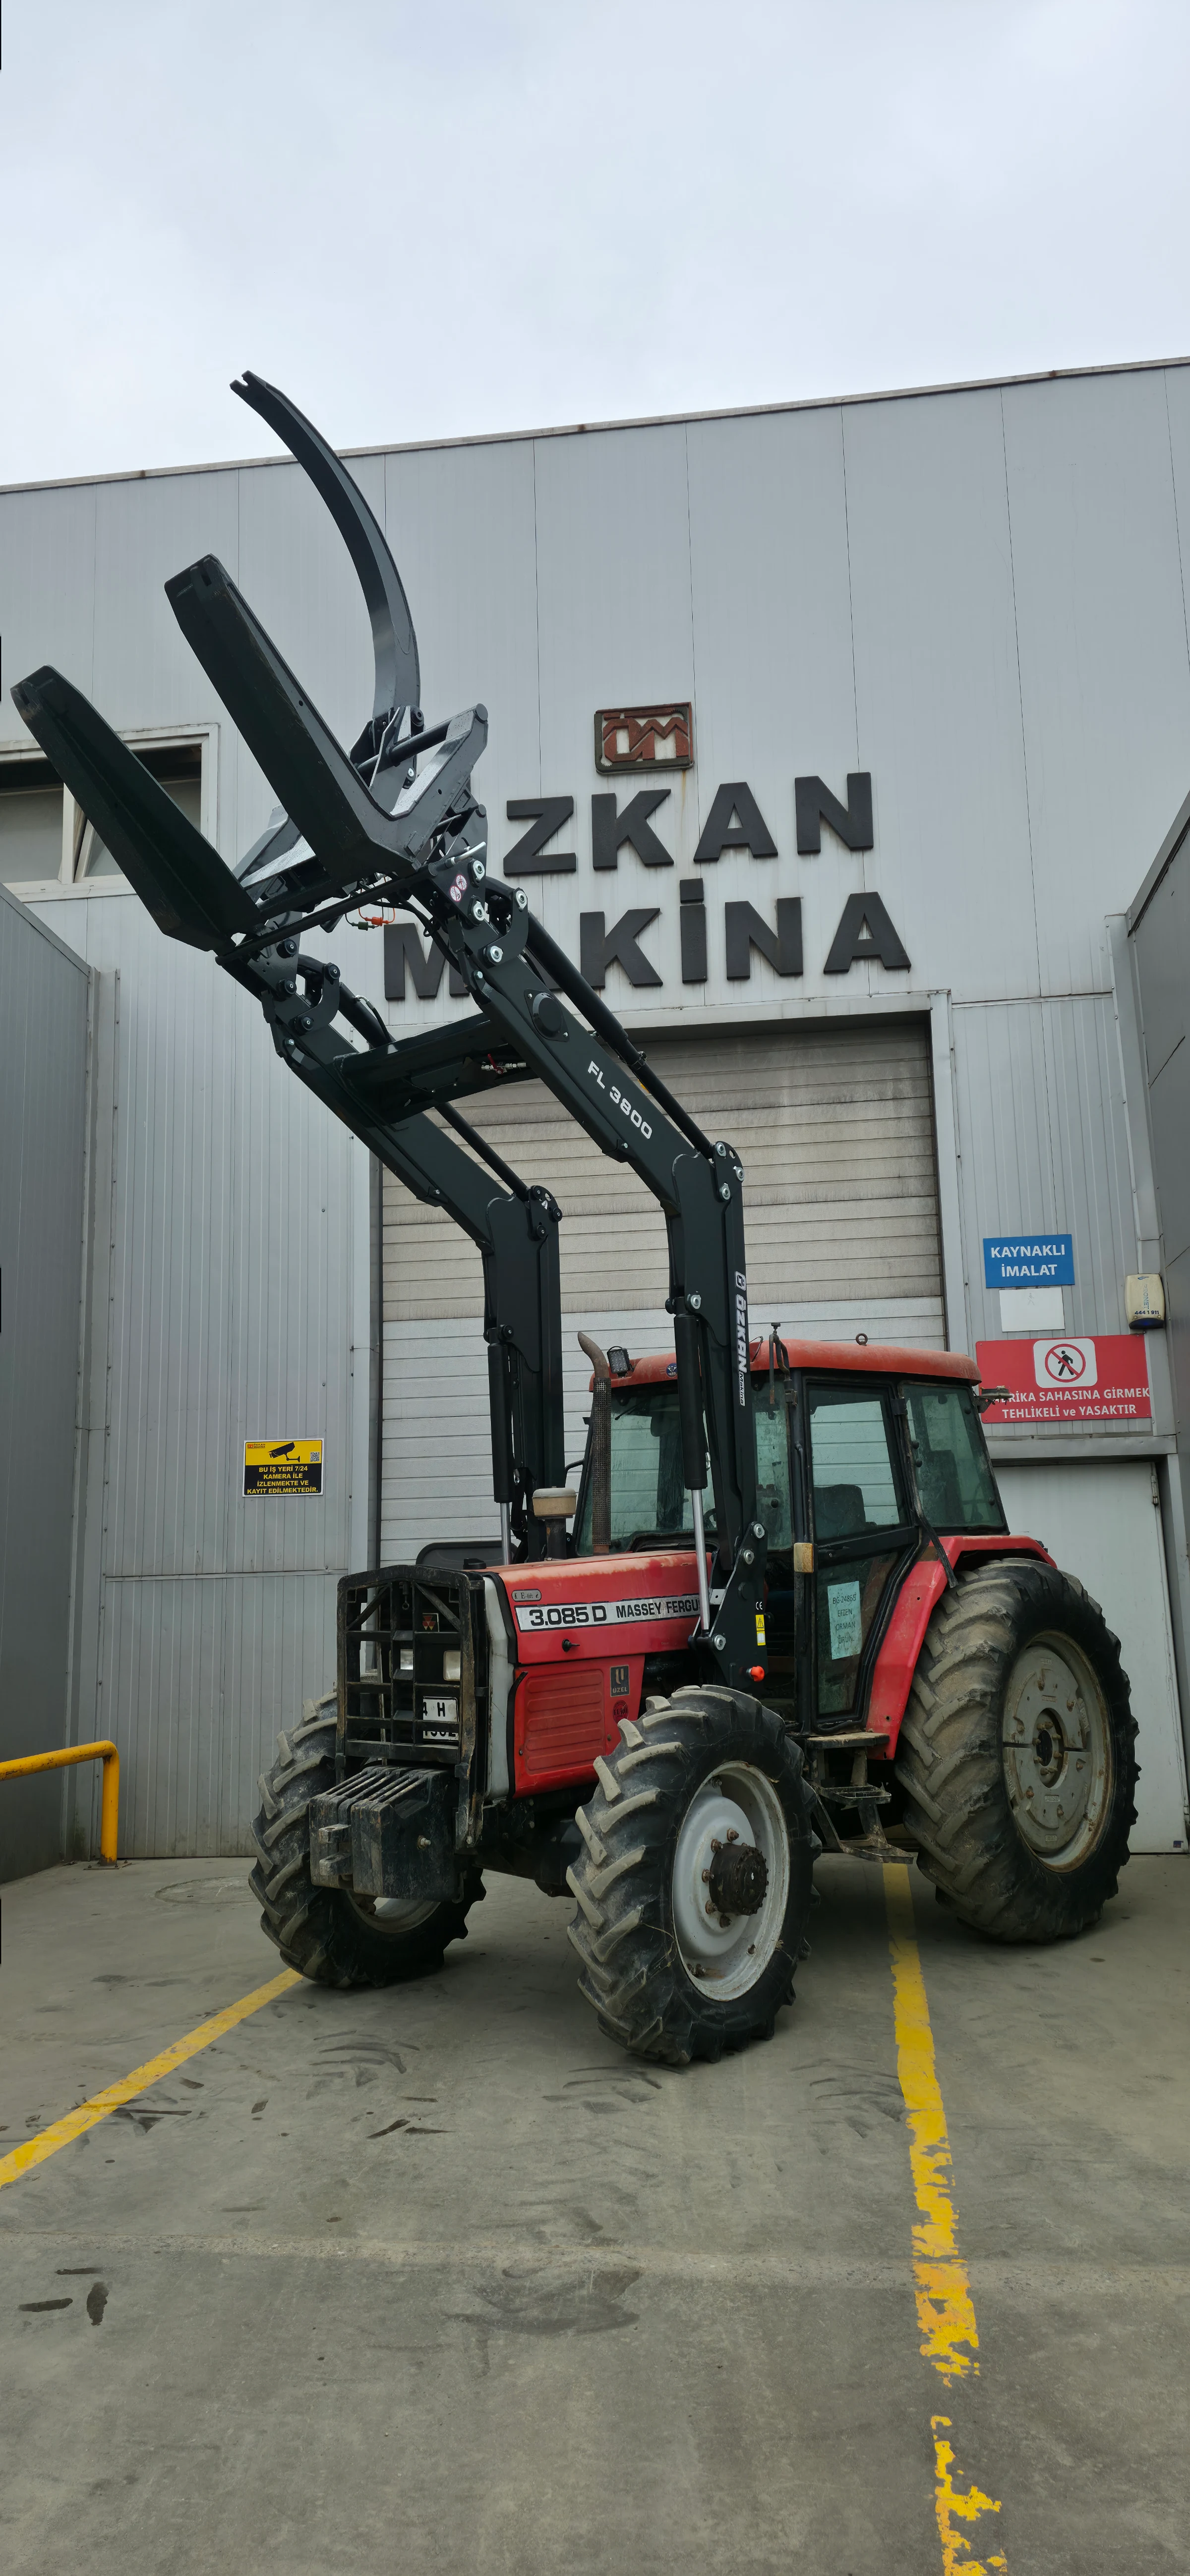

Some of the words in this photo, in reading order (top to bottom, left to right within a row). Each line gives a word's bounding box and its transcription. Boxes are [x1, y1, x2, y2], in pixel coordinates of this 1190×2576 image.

[503, 772, 874, 876] ZKAN
[383, 877, 911, 1000] MKİNA
[588, 1060, 605, 1089] FL
[609, 1086, 653, 1139] 3800
[991, 1244, 1066, 1258] KAYNAKLI
[1002, 1263, 1058, 1277] İMALAT
[736, 1294, 747, 1374] ÖZKAN
[993, 1391, 1036, 1403] RİKA
[1040, 1389, 1100, 1402] SAHASINA
[1104, 1387, 1150, 1399] GİRMEK
[1002, 1405, 1060, 1419] TEHLİKELİ
[1079, 1404, 1136, 1416] YASAKTIR
[529, 1606, 589, 1626] 3.085
[592, 1605, 607, 1622] D
[616, 1602, 662, 1618] MASSEY
[836, 1621, 855, 1631] ORMAN
[437, 1702, 445, 1717] H
